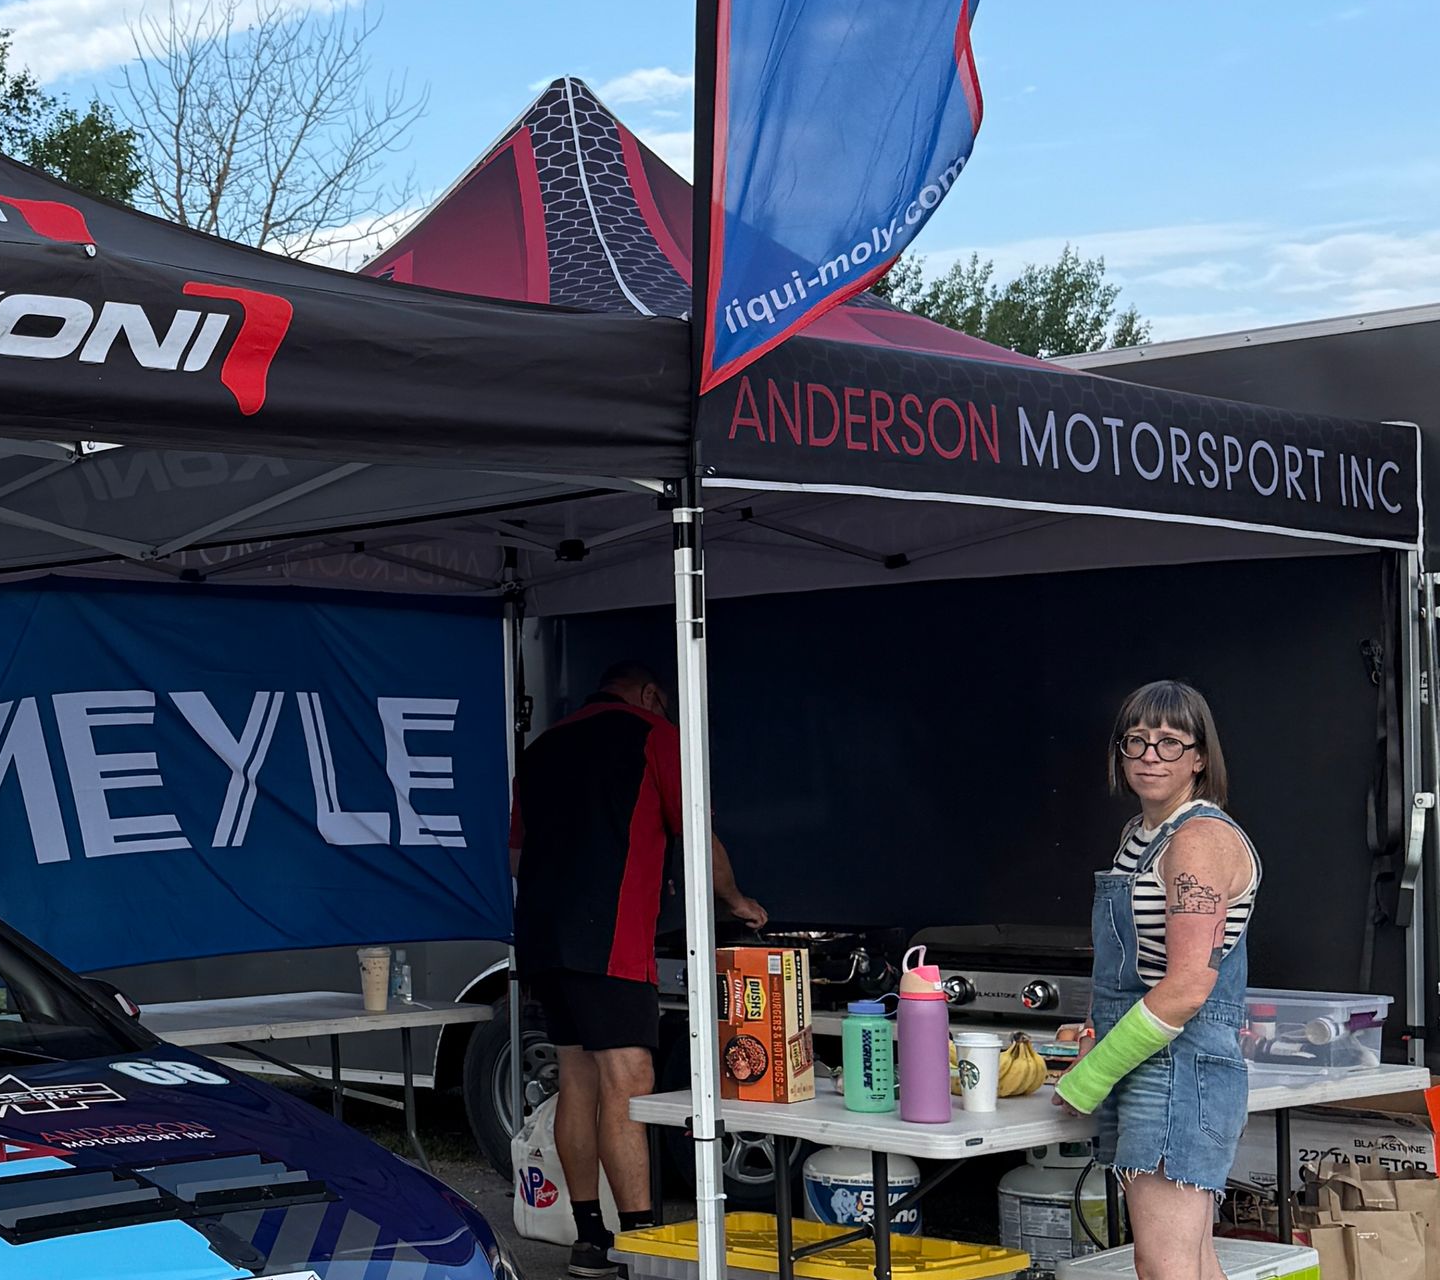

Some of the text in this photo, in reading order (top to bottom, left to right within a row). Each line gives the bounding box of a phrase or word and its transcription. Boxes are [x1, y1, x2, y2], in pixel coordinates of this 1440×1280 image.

[725, 155, 967, 336] liqui-moly.com
[728, 375, 1403, 515] ANDERSON MOTORSPORT INC
[109, 1061, 231, 1086] 68
[39, 1120, 211, 1144] ANDERSON
[61, 1132, 182, 1150] MOTORSPORT
